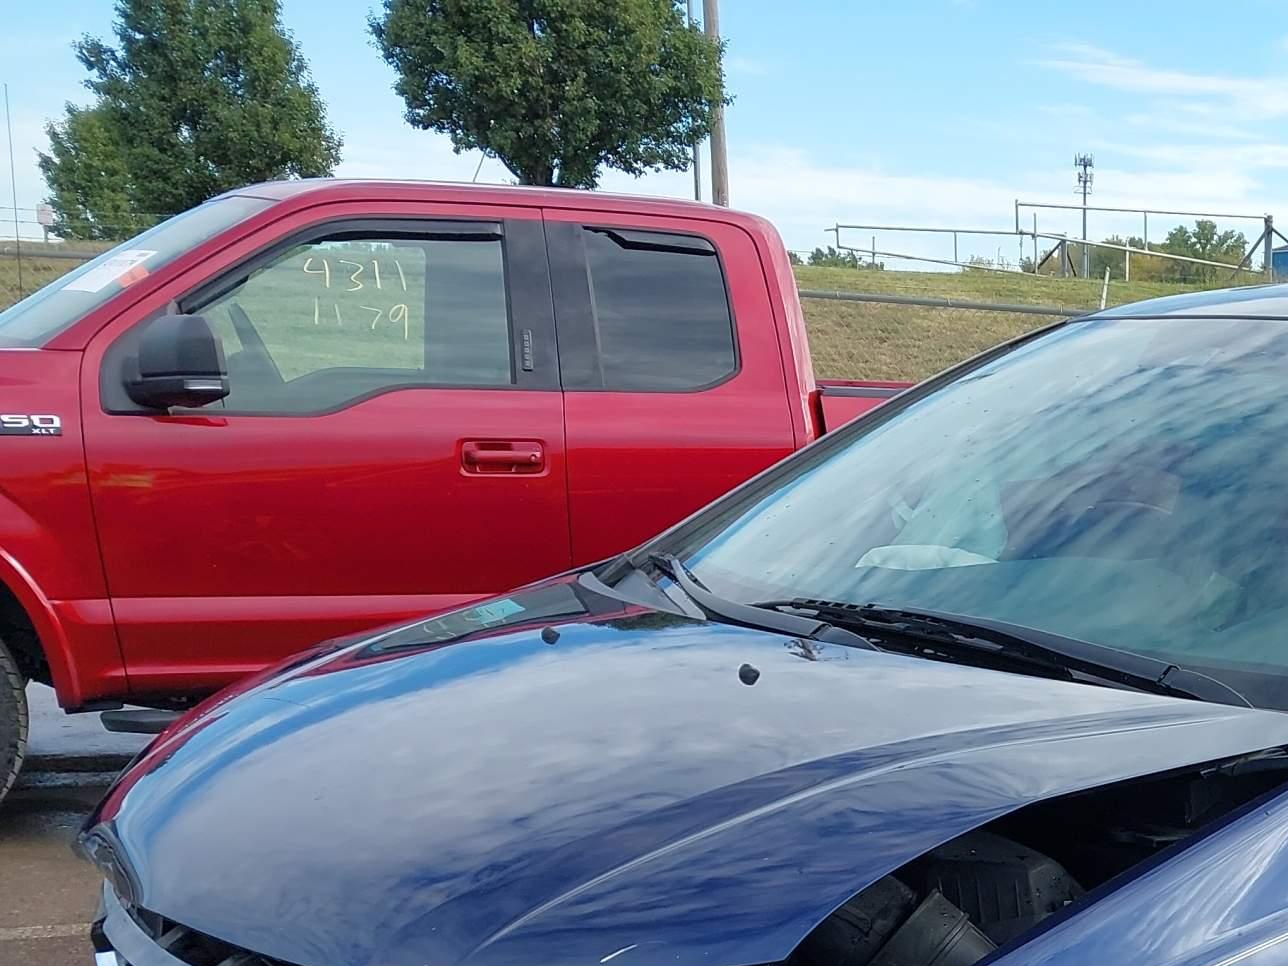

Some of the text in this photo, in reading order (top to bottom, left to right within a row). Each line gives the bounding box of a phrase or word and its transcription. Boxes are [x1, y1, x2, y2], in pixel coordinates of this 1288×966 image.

[303, 257, 407, 292] 4311
[313, 296, 409, 341] 1179
[31, 427, 57, 435] XLT
